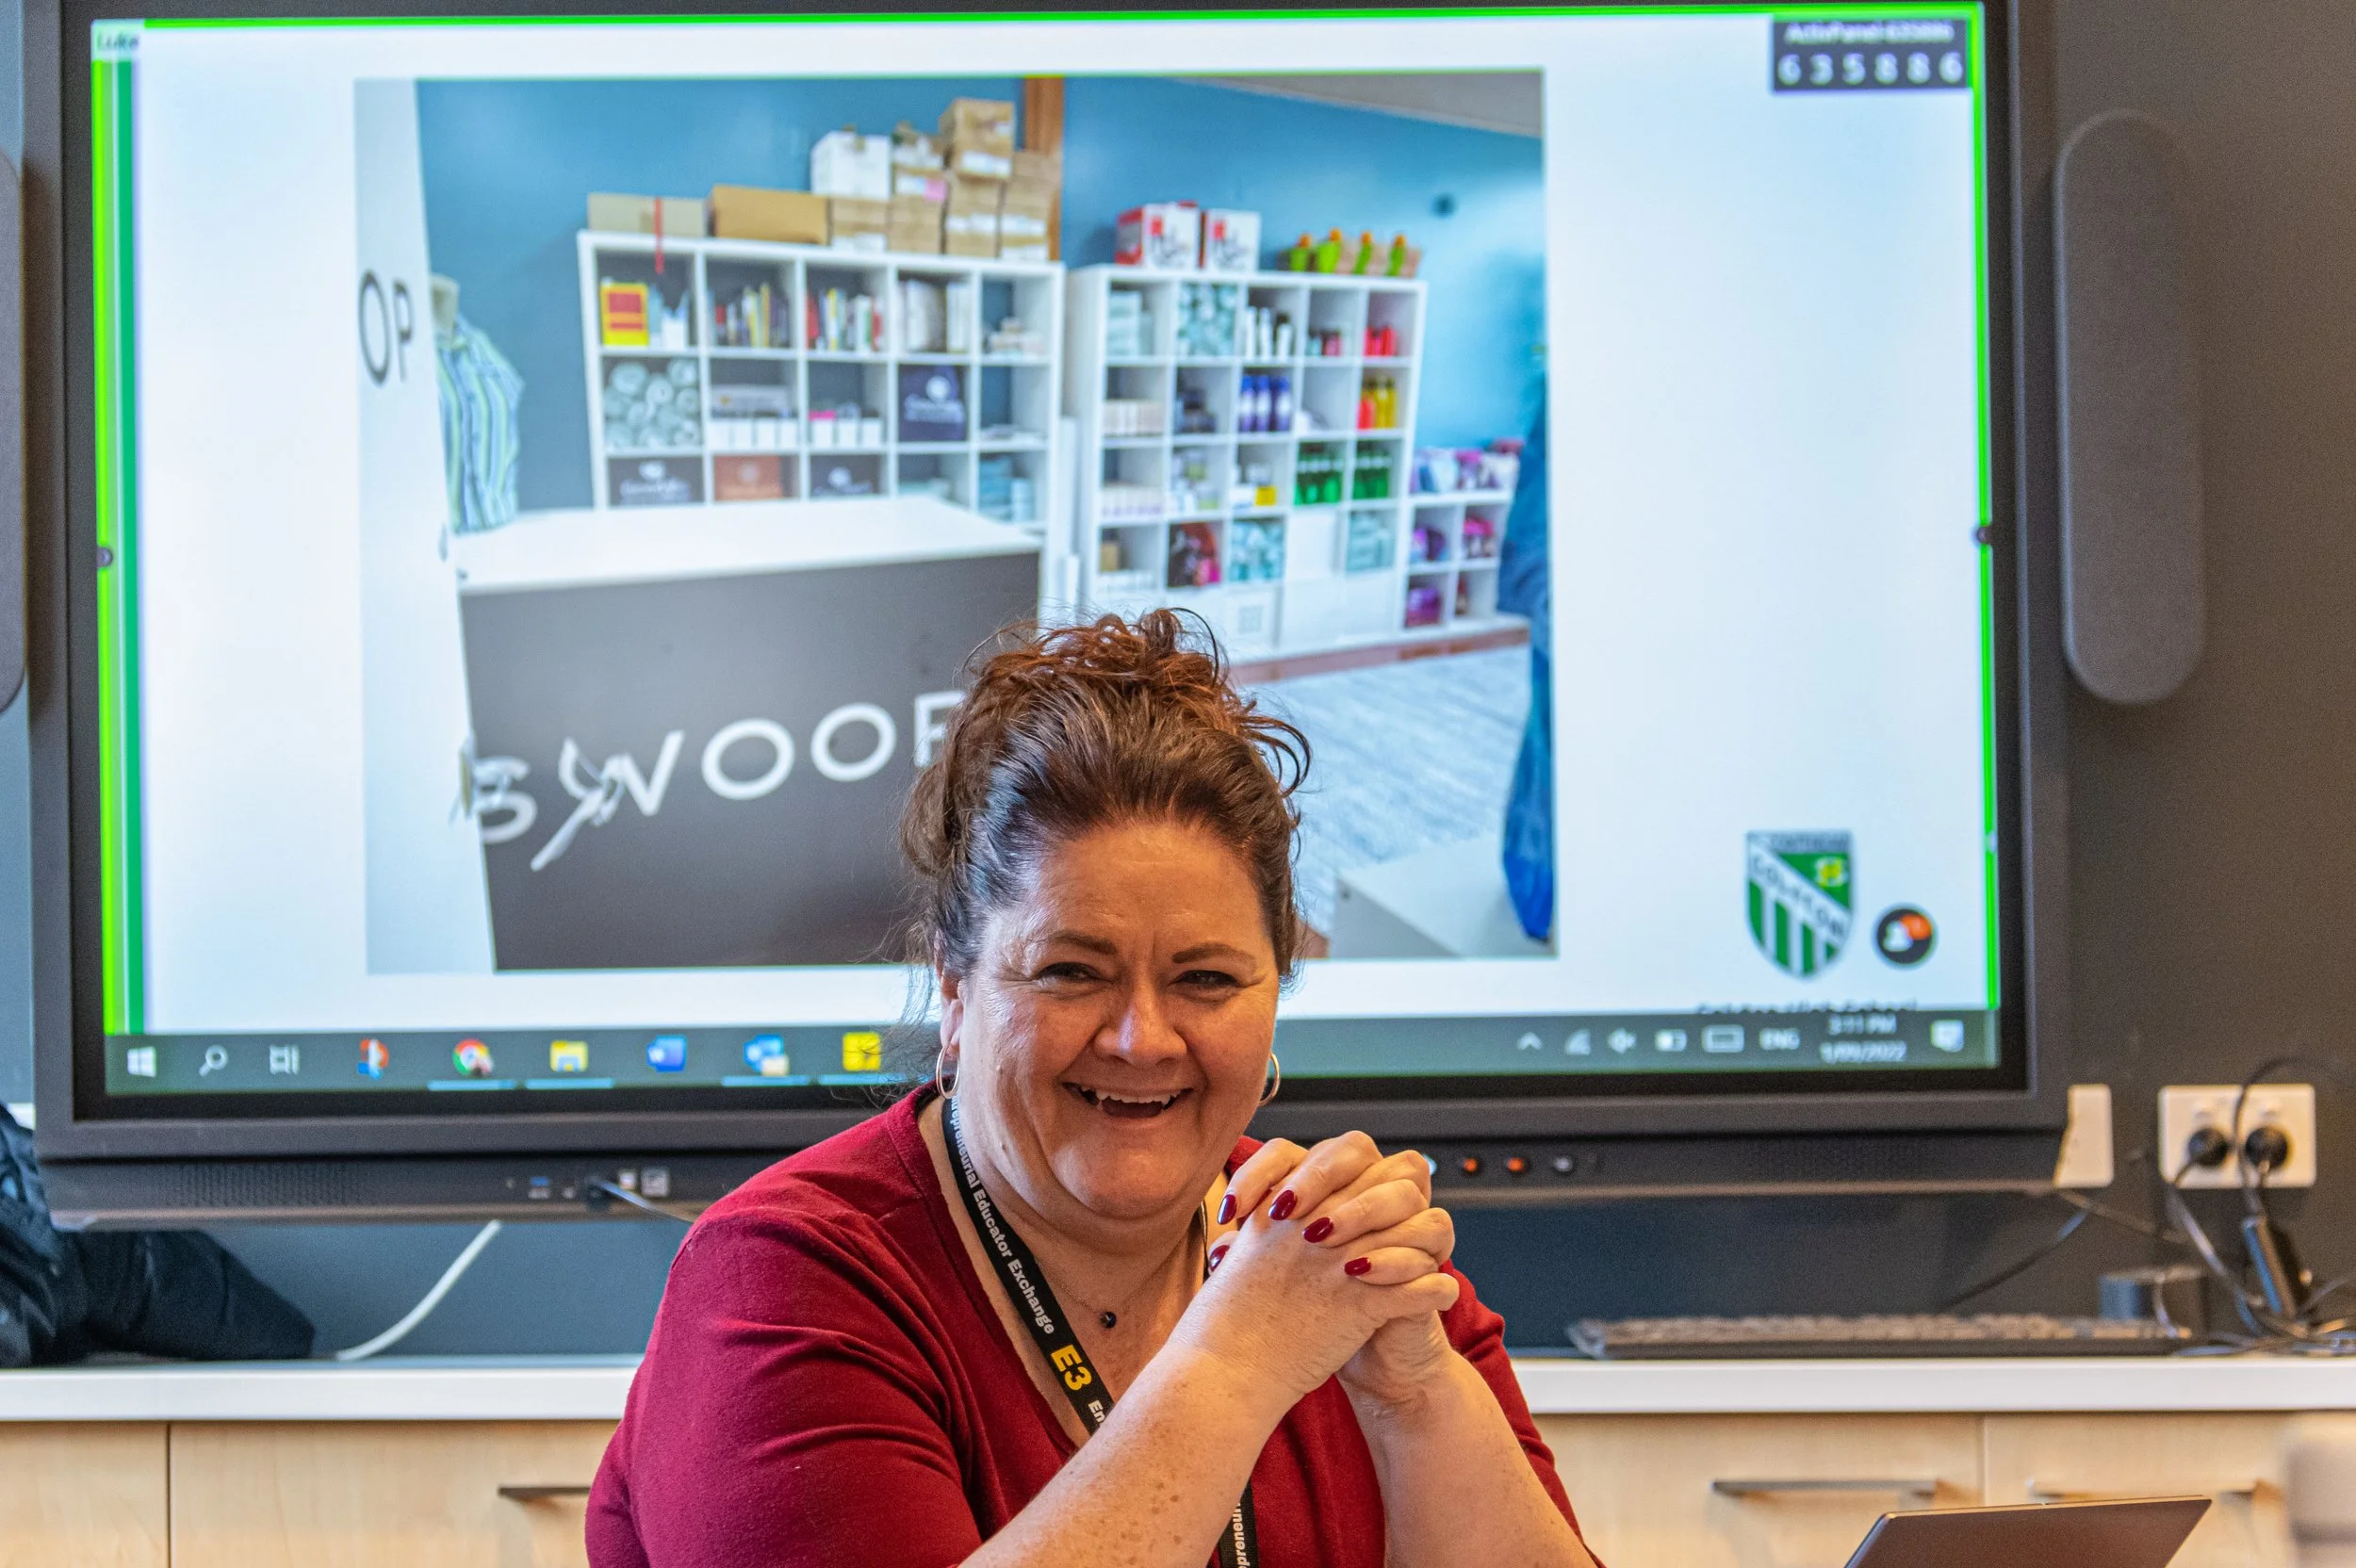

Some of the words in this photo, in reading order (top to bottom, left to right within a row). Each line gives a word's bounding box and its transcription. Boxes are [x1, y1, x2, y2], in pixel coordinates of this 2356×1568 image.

[973, 1188, 1013, 1258] Educator
[1007, 1258, 1055, 1335] Exchange
[1051, 1344, 1092, 1391] E3
